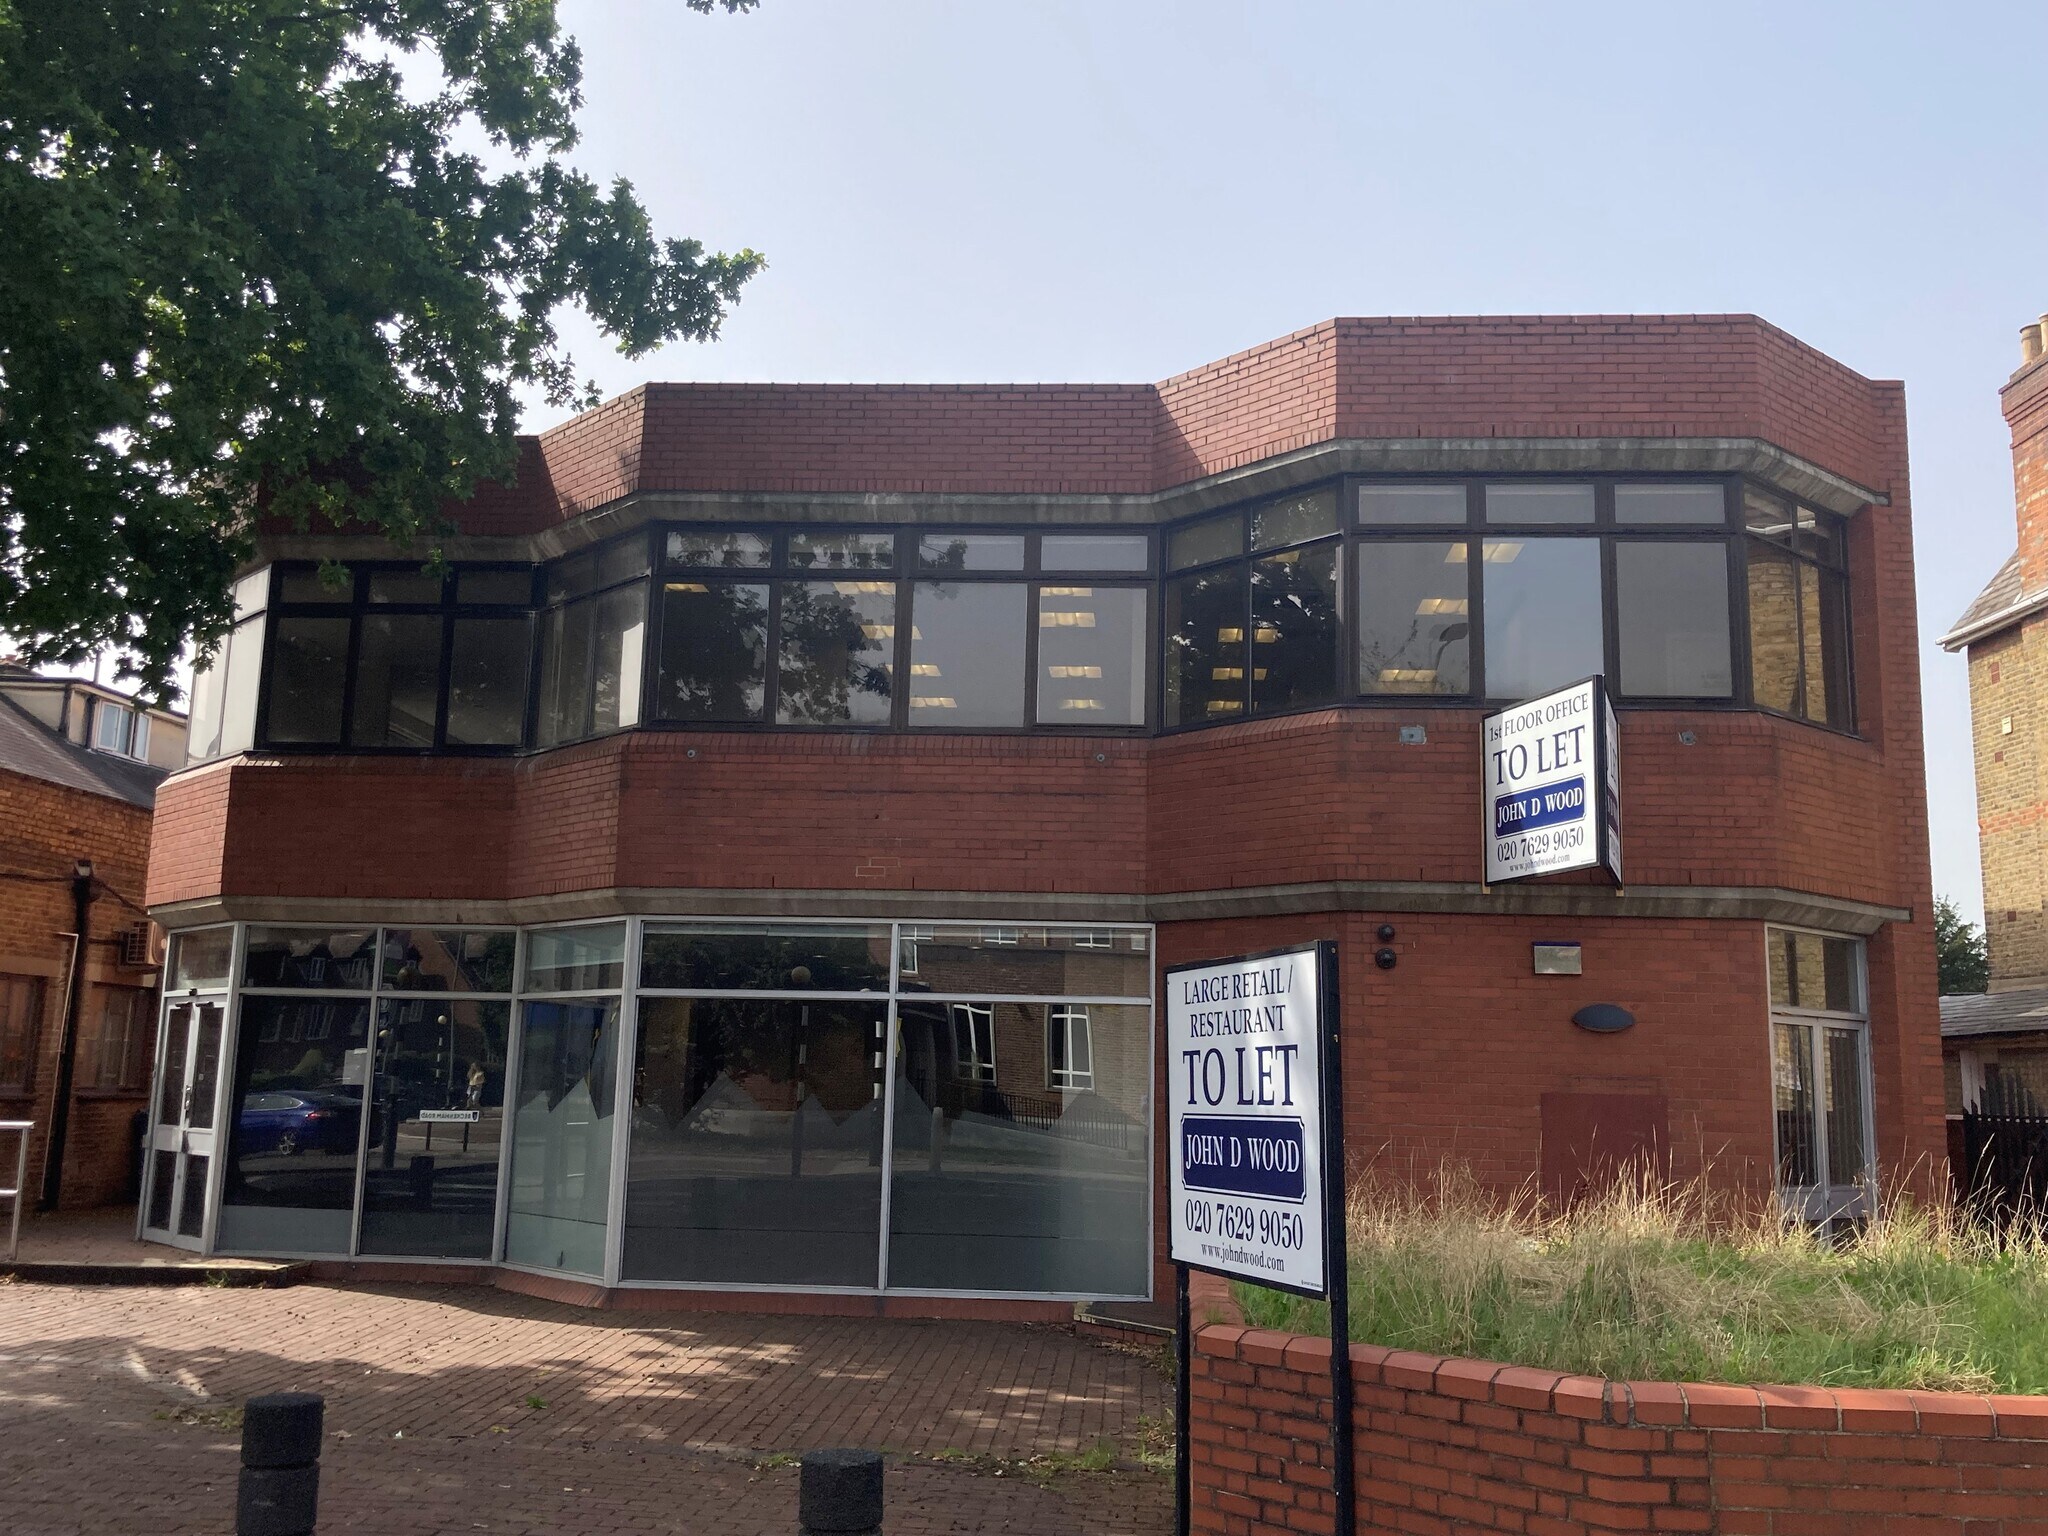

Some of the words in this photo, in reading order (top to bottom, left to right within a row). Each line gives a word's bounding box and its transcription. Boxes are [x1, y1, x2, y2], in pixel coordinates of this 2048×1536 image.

[1489, 726, 1502, 742] 1st
[1504, 709, 1543, 737] FLOOR
[1545, 692, 1589, 722] OFFICE
[1492, 743, 1528, 785] TO
[1535, 724, 1586, 774] LET
[1497, 800, 1527, 828] JOHN
[1531, 797, 1541, 817] D
[1544, 787, 1584, 813] WOOD
[1497, 840, 1517, 862] 020
[1520, 833, 1550, 857] 7629
[1553, 826, 1584, 850] 9050
[1509, 853, 1571, 872] www.johndwood.com
[1184, 975, 1229, 1005] LARGE
[1232, 967, 1285, 996] RETAIL
[1287, 964, 1293, 994] /
[1190, 1004, 1286, 1038] RESTAURANT
[1182, 1048, 1226, 1106] TO
[1235, 1044, 1299, 1106] LET
[1185, 1134, 1224, 1170] JOHN
[1230, 1136, 1242, 1168] D
[1247, 1137, 1300, 1173] WOOD
[1185, 1199, 1212, 1235] 020
[1216, 1203, 1255, 1242] 7629
[1260, 1209, 1303, 1251] 9050
[1201, 1242, 1285, 1272] www.johndwood.com
